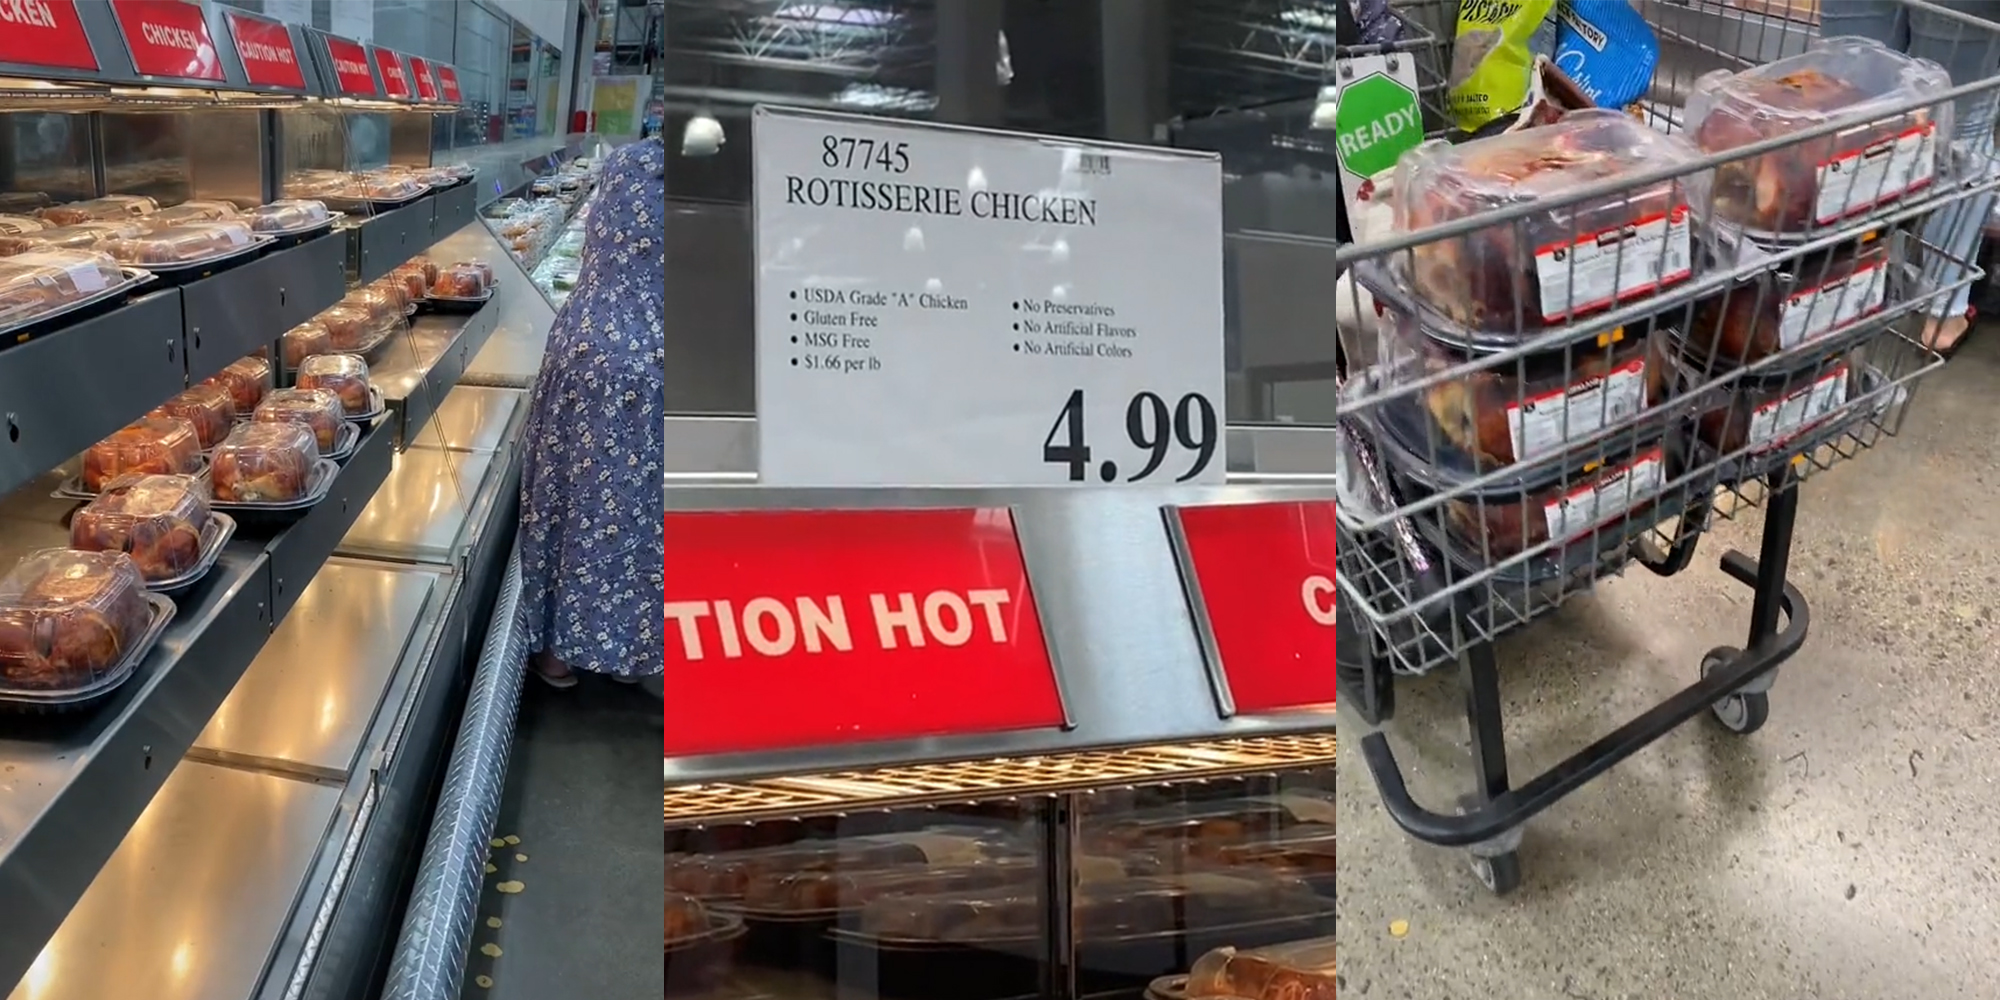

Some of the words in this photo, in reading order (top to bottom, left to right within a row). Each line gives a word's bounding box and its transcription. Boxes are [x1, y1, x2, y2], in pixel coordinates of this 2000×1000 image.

[141, 21, 200, 51] CHICKEN
[239, 40, 278, 63] CAUTION
[276, 47, 295, 64] HOT
[1338, 103, 1416, 159] READY
[821, 135, 910, 173] 87745
[786, 176, 962, 216] ROTISSERIE
[970, 191, 1097, 226] CHICKEN
[804, 289, 845, 304] USDA
[849, 291, 887, 307] Grade
[892, 292, 913, 308] "A"
[919, 294, 968, 310] Chicken
[1023, 300, 1040, 314] No
[1044, 301, 1115, 317] Preservatives
[804, 311, 847, 326] Gluten
[850, 313, 878, 328] Free
[1024, 321, 1040, 335] No
[1044, 322, 1094, 337] Artificial
[1097, 324, 1137, 339] Flavors
[805, 333, 838, 348] MSG
[842, 334, 870, 349] Free
[1024, 341, 1040, 355] No
[1044, 342, 1094, 357] Artificial
[1097, 344, 1132, 358] Colors
[804, 354, 841, 370] $1.66
[844, 358, 865, 374] per
[869, 356, 881, 371] lb
[1043, 389, 1218, 483] 4.99
[664, 595, 852, 661] TION
[871, 588, 1011, 649] HOT
